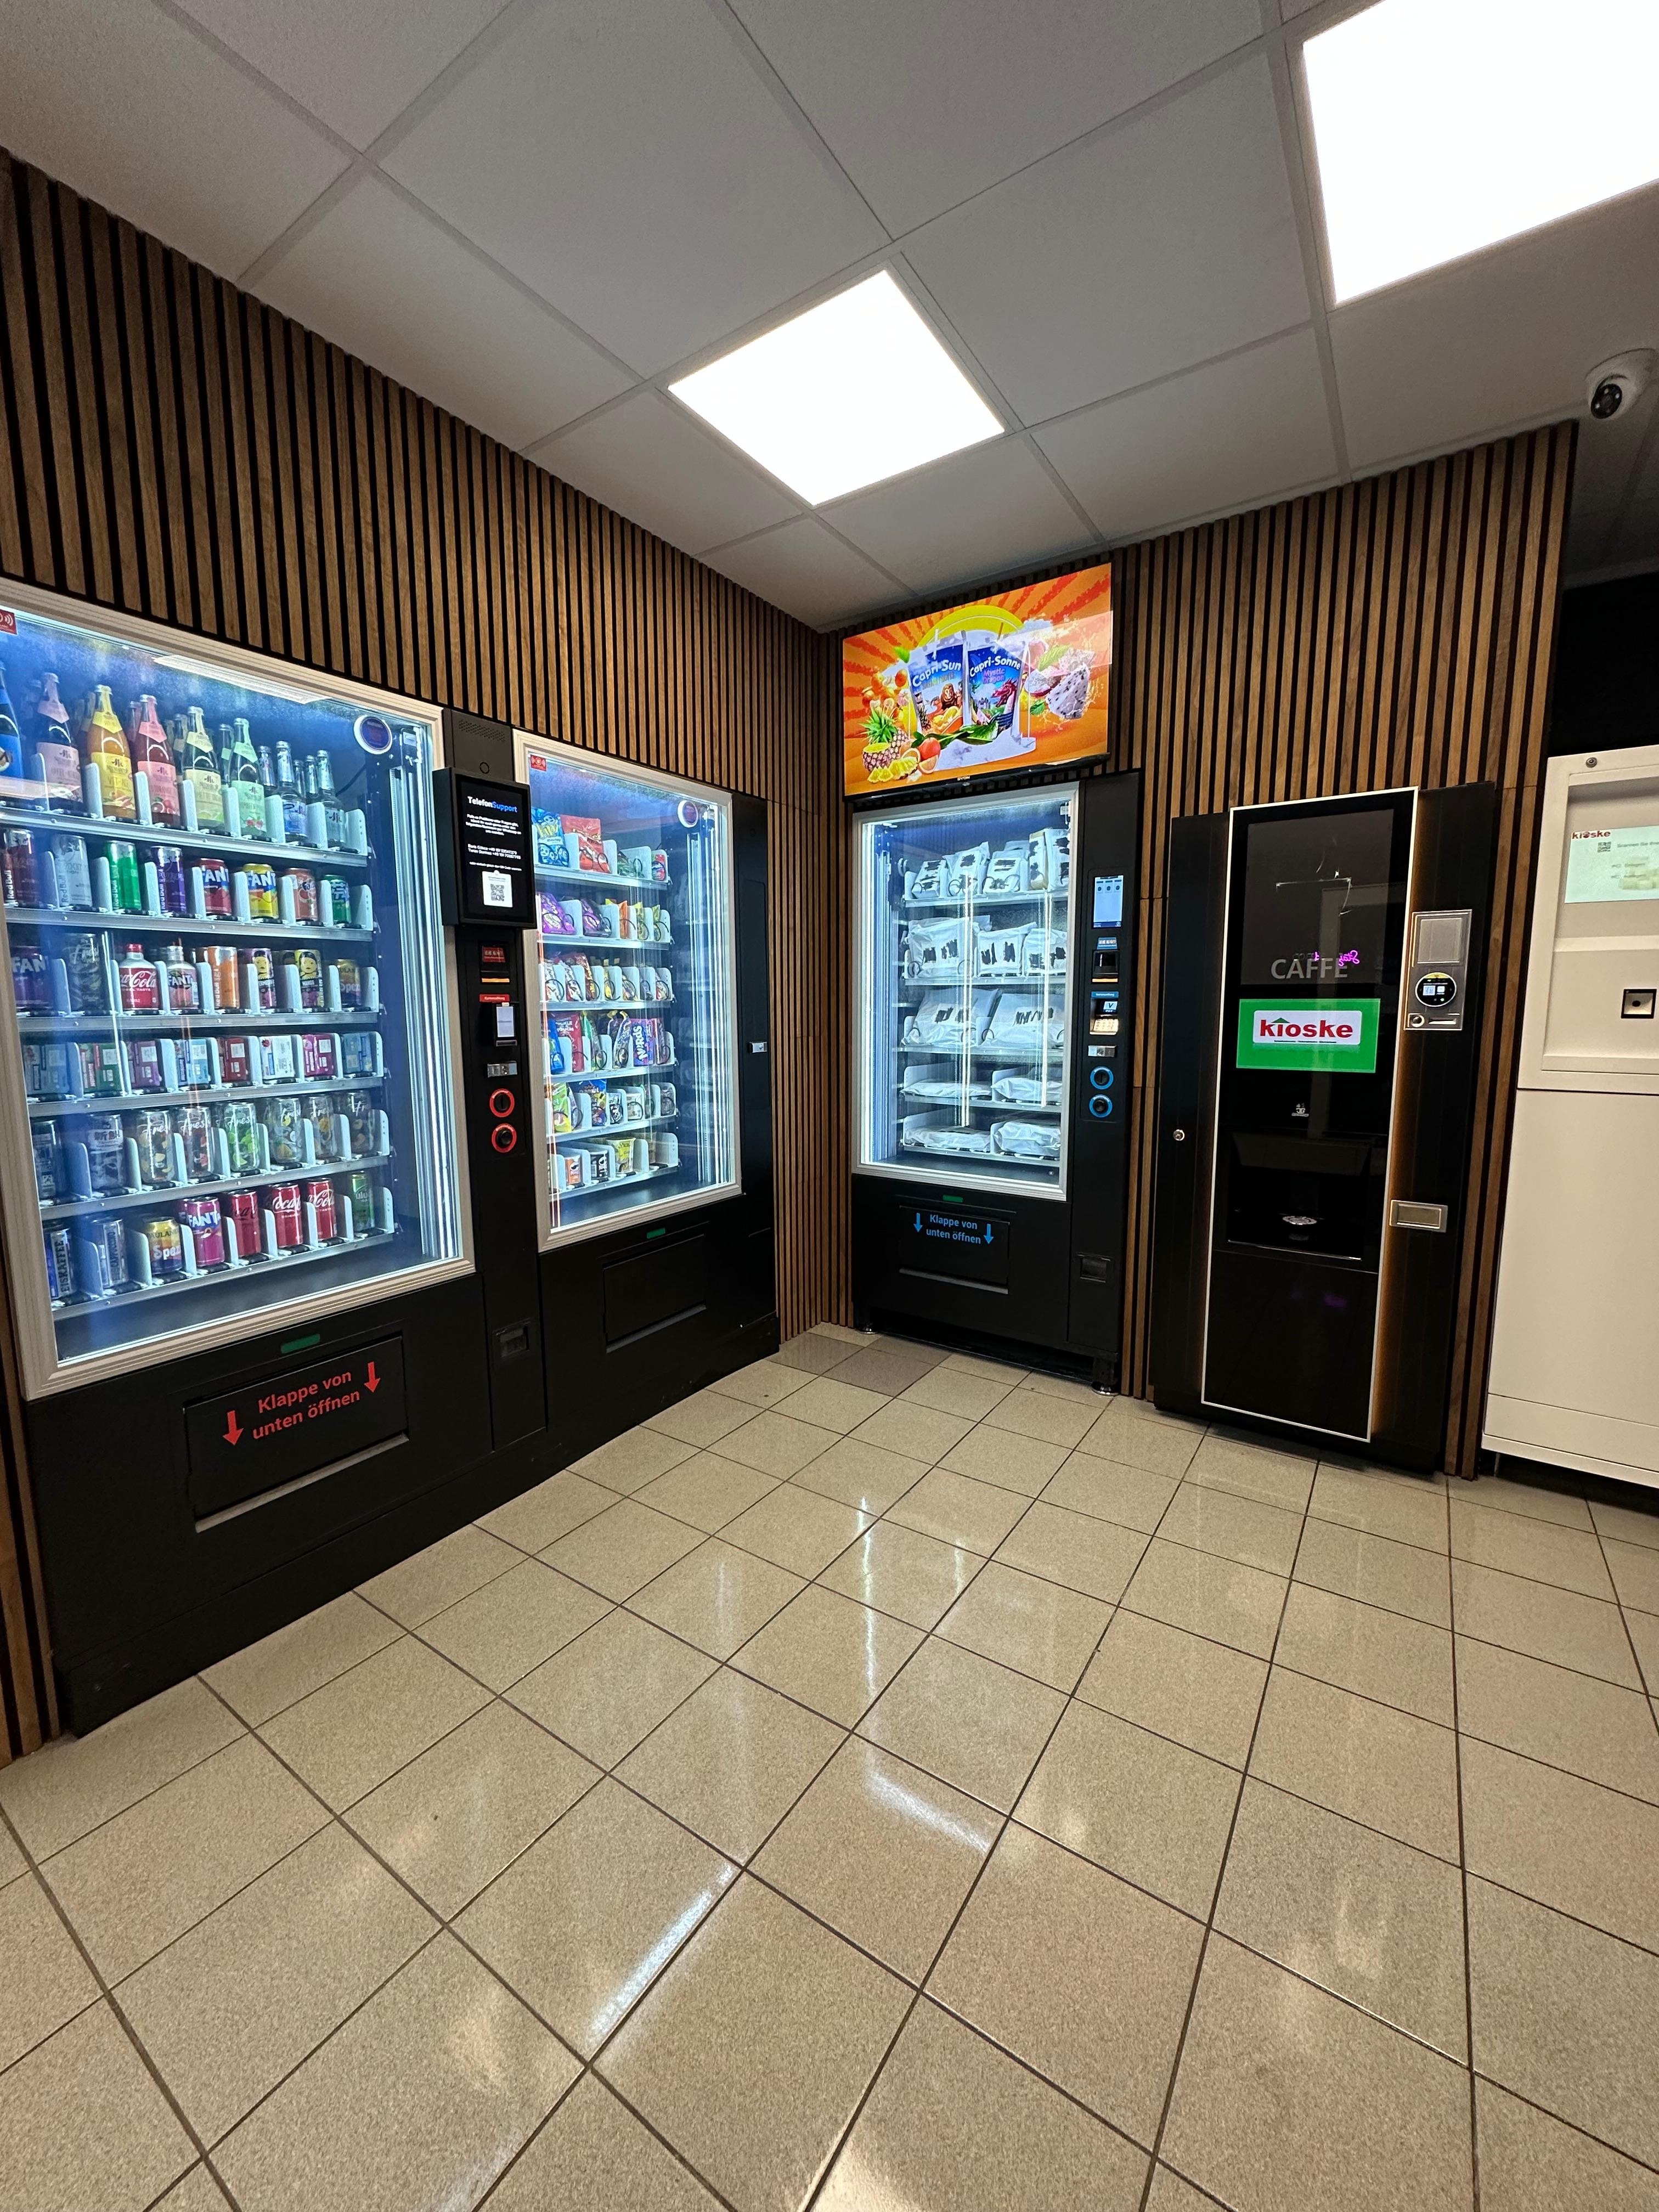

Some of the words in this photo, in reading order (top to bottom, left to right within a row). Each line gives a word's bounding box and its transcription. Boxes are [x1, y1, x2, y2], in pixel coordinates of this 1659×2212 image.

[969, 656, 1021, 677] Capri-Sonne
[983, 668, 1006, 678] Mystic
[983, 675, 1005, 684] Dragon
[467, 795, 518, 813] TelefonSupport
[1571, 830, 1611, 839] kioske
[201, 865, 229, 883] FANT
[247, 870, 276, 887] FANT
[59, 889, 69, 903] Red
[1260, 1018, 1353, 1039] kioske
[929, 1214, 959, 1227] Klappe
[962, 1219, 978, 1229] von
[926, 1228, 950, 1239] unten
[952, 1231, 981, 1244] öffnen
[258, 1383, 318, 1413] Klappe
[323, 1372, 352, 1390] von
[253, 1412, 303, 1440] unten
[307, 1390, 360, 1419] öffnen
